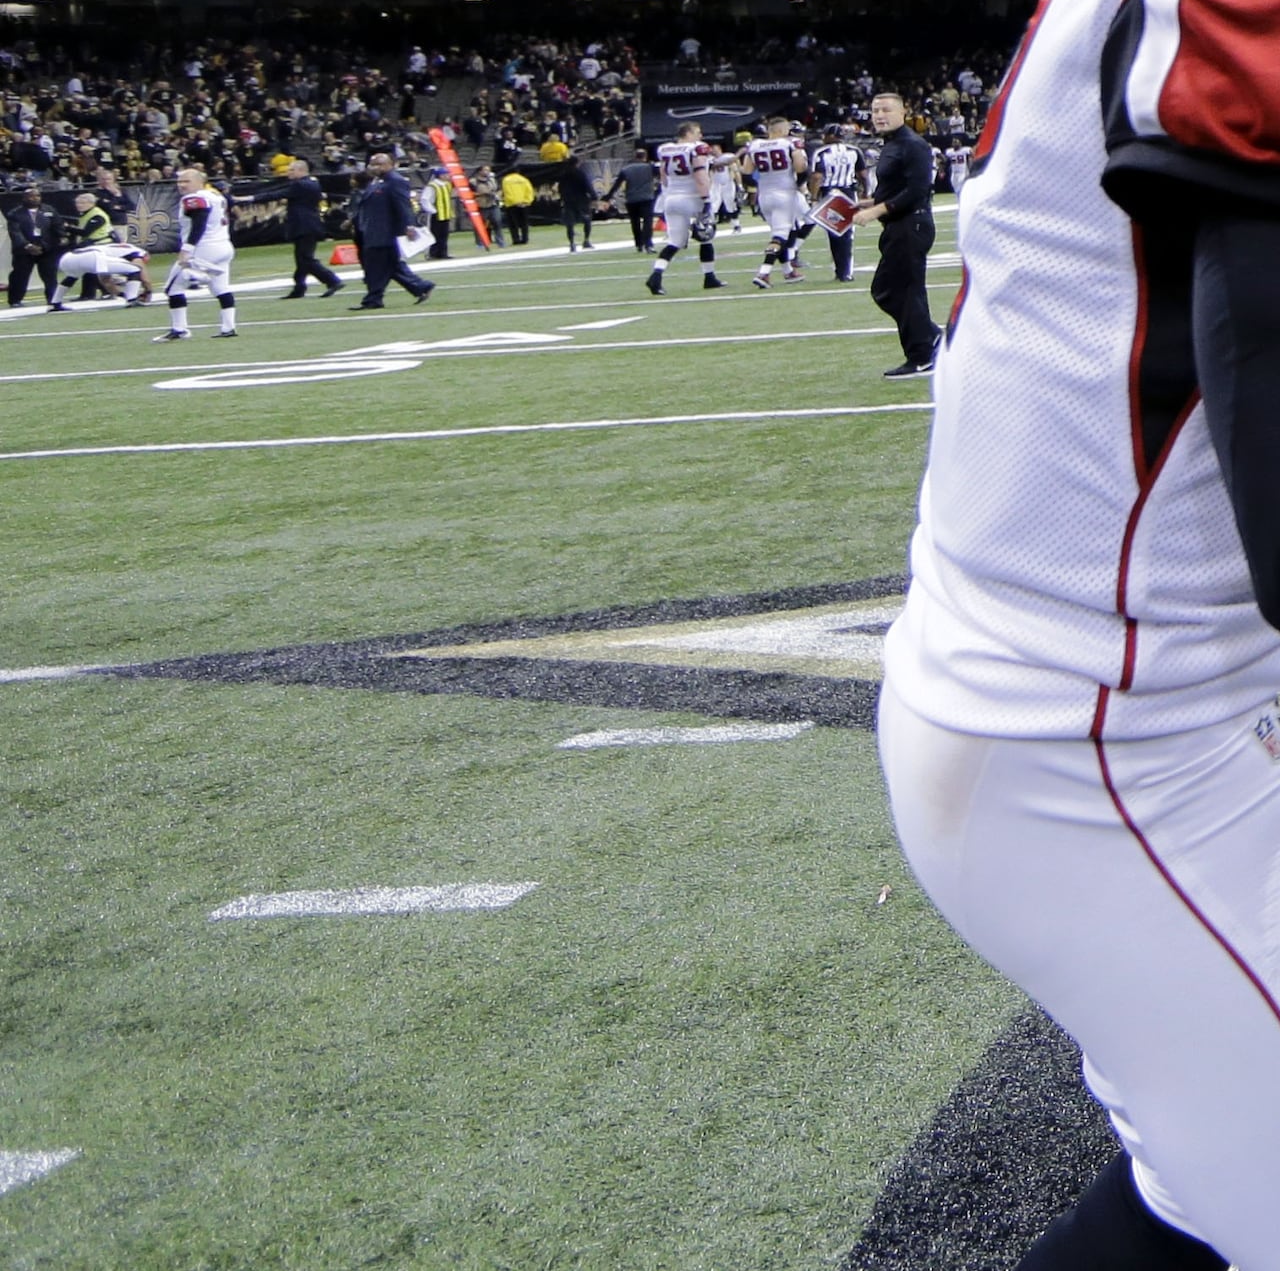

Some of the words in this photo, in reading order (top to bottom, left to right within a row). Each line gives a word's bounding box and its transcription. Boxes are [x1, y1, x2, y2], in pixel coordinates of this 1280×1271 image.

[658, 82, 738, 94] Mercedes-Benz
[743, 81, 801, 91] Superdome
[661, 154, 690, 176] 73
[754, 149, 788, 173] 68
